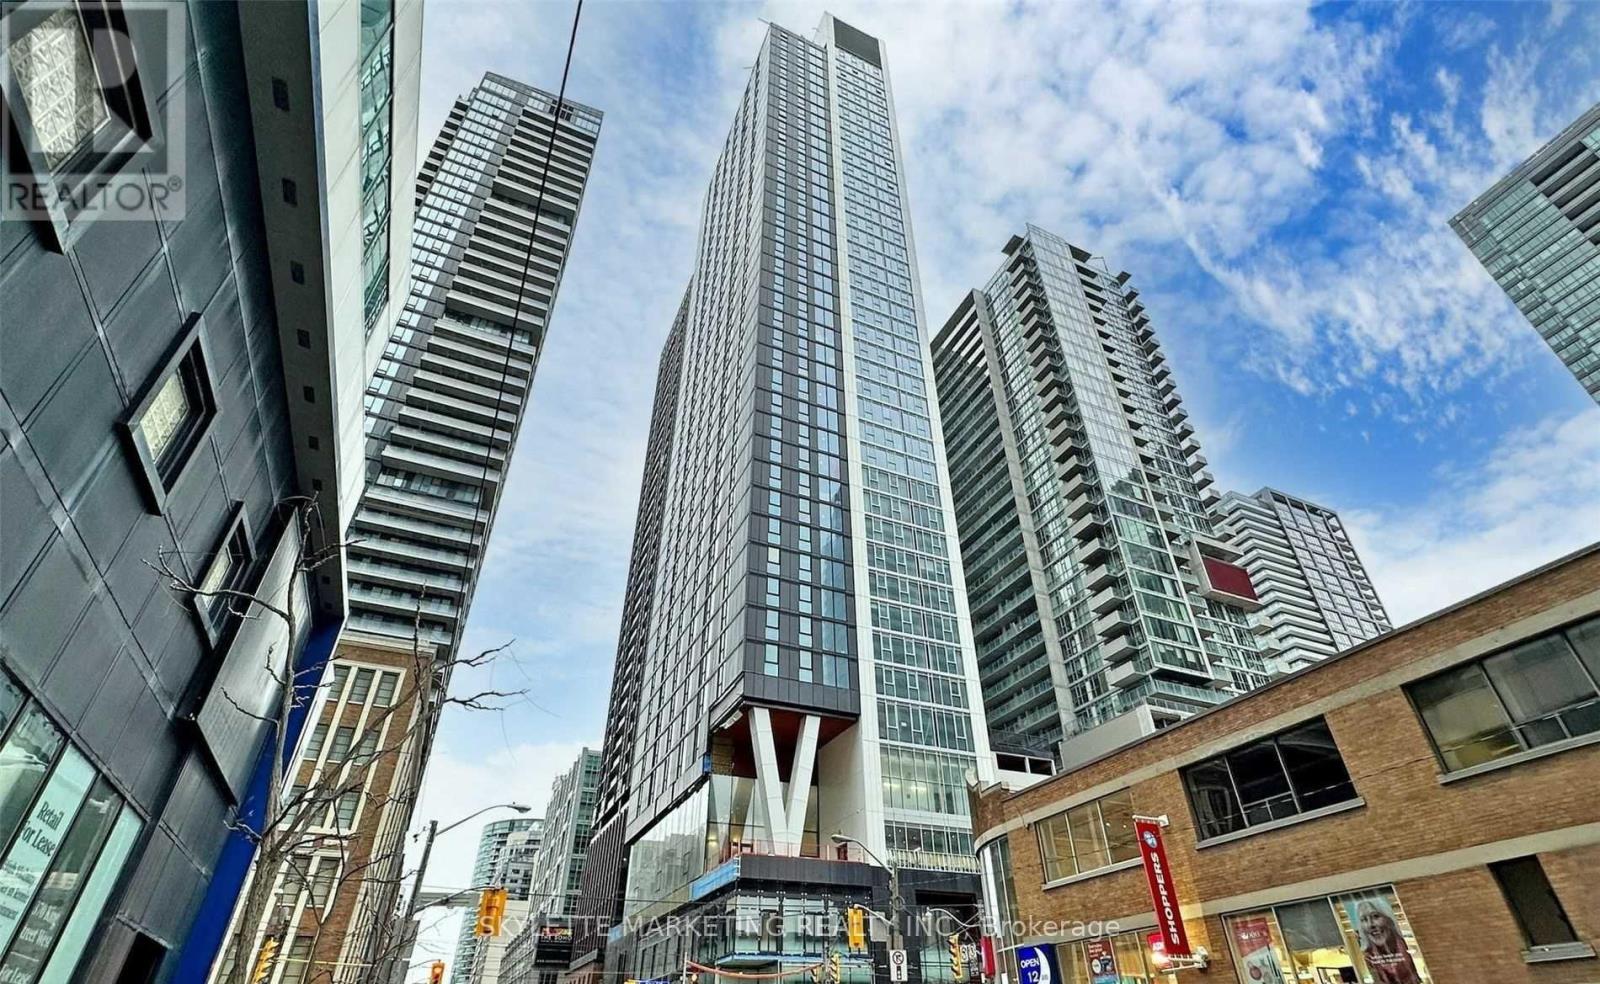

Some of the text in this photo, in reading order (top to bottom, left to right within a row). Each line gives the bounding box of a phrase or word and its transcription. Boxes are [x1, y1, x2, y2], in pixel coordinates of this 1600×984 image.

[37, 801, 65, 831] Retail
[33, 829, 56, 858] Lease
[1150, 851, 1180, 946] SHOPPERS
[1020, 958, 1040, 968] OPEN
[1028, 970, 1040, 983] 12
